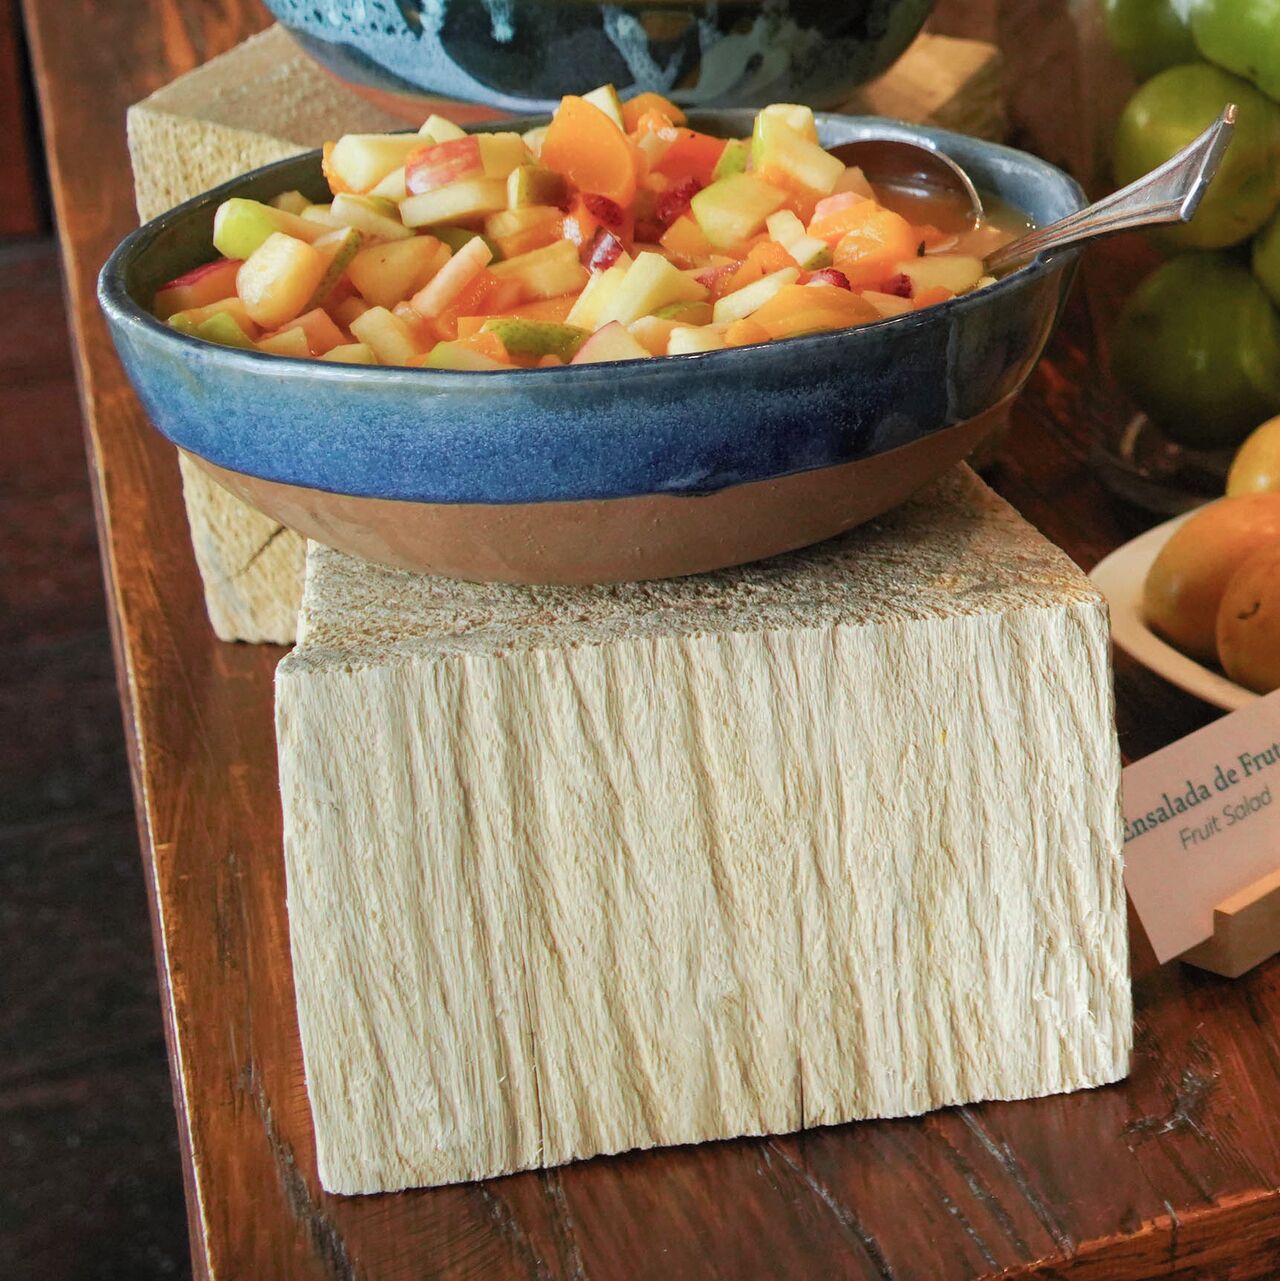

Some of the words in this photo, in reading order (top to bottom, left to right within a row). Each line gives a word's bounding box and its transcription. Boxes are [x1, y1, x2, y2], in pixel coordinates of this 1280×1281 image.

[1214, 764, 1240, 793] de
[1178, 814, 1220, 851] Fruit
[1222, 784, 1273, 828] Salad
